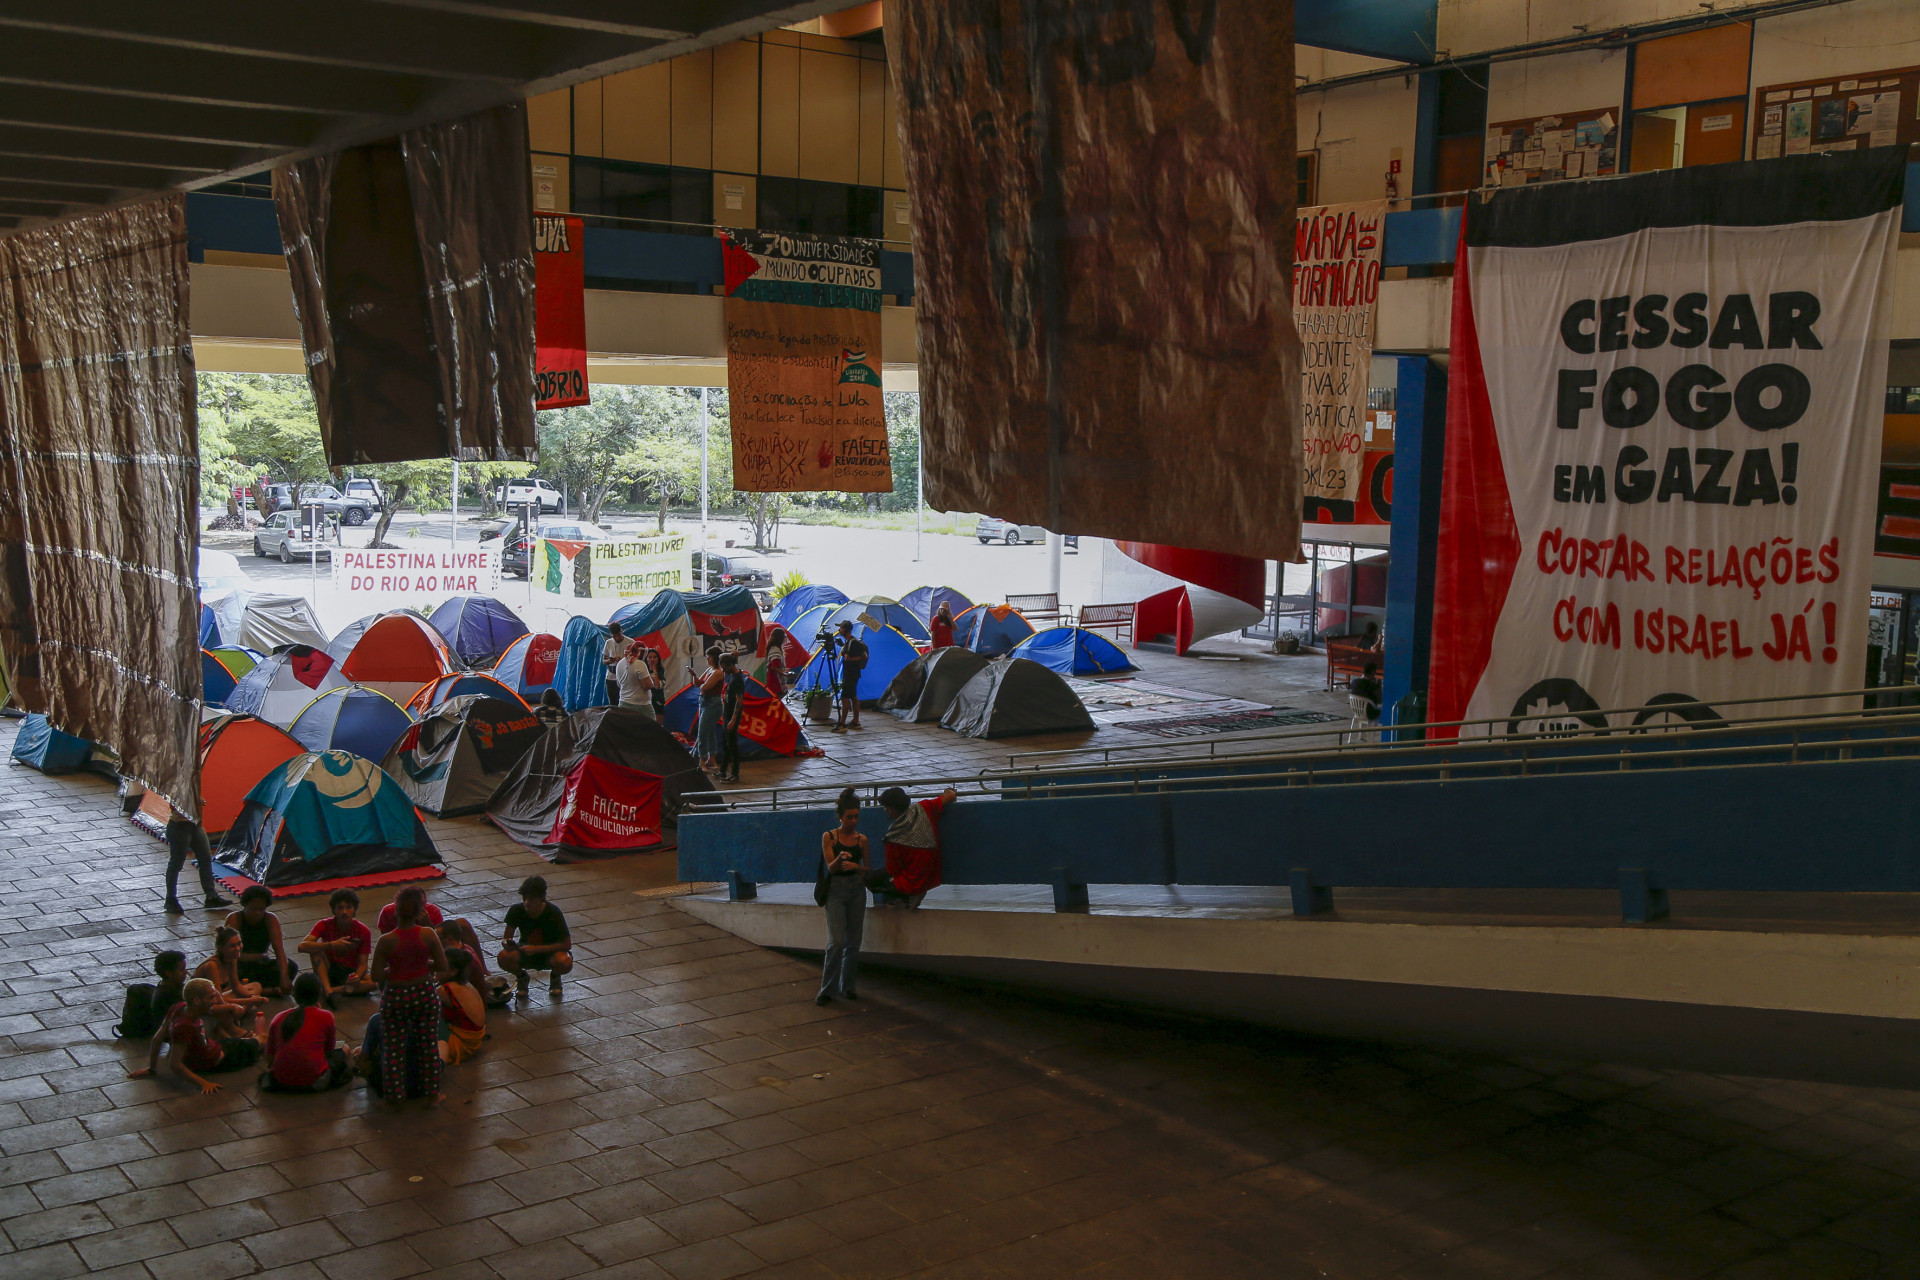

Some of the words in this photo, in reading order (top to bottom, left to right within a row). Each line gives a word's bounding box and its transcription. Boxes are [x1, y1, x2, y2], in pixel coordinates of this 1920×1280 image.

[1358, 219, 1377, 250] DE
[792, 241, 875, 266] UNIVERSIDADES
[765, 258, 806, 280] MUNDO
[808, 263, 876, 287] OCUPADAS
[1293, 254, 1380, 312] FORMAÇÃO
[812, 284, 881, 312] PALESTINA
[1561, 291, 1823, 354] CESSAR
[779, 328, 811, 348] legado
[731, 351, 779, 364] movimento
[1337, 372, 1350, 396] &
[764, 392, 817, 409] conciliação
[823, 397, 832, 407] de
[839, 390, 870, 406] Lula
[1556, 363, 1811, 431] FOGO
[743, 412, 754, 424] que
[757, 408, 795, 423] fortalece
[853, 411, 887, 432] direita!
[741, 432, 795, 454] REUNIÃO
[843, 436, 889, 456] FAÍSCA
[1332, 432, 1361, 455] VÃO
[742, 452, 773, 472] CHAPA
[779, 454, 806, 476] DCE
[1554, 465, 1606, 504] EM
[1614, 442, 1799, 506] GAZA!
[1326, 469, 1346, 489] 23
[596, 543, 652, 559] PALESTINA
[655, 537, 685, 554] LIVRE!
[344, 553, 436, 569] PALESTINA
[442, 553, 488, 569] LIVRE
[1537, 527, 1655, 582] CORTAR
[1665, 536, 1840, 600] RELAÇÕES
[351, 576, 374, 591] DO
[381, 576, 410, 591] RIO
[415, 576, 437, 591] AO
[443, 576, 477, 591] MAR
[1554, 595, 1621, 650] COM
[1635, 607, 1753, 660] ISRAEL
[495, 721, 509, 735] Já
[592, 794, 637, 821] FAÍSCA
